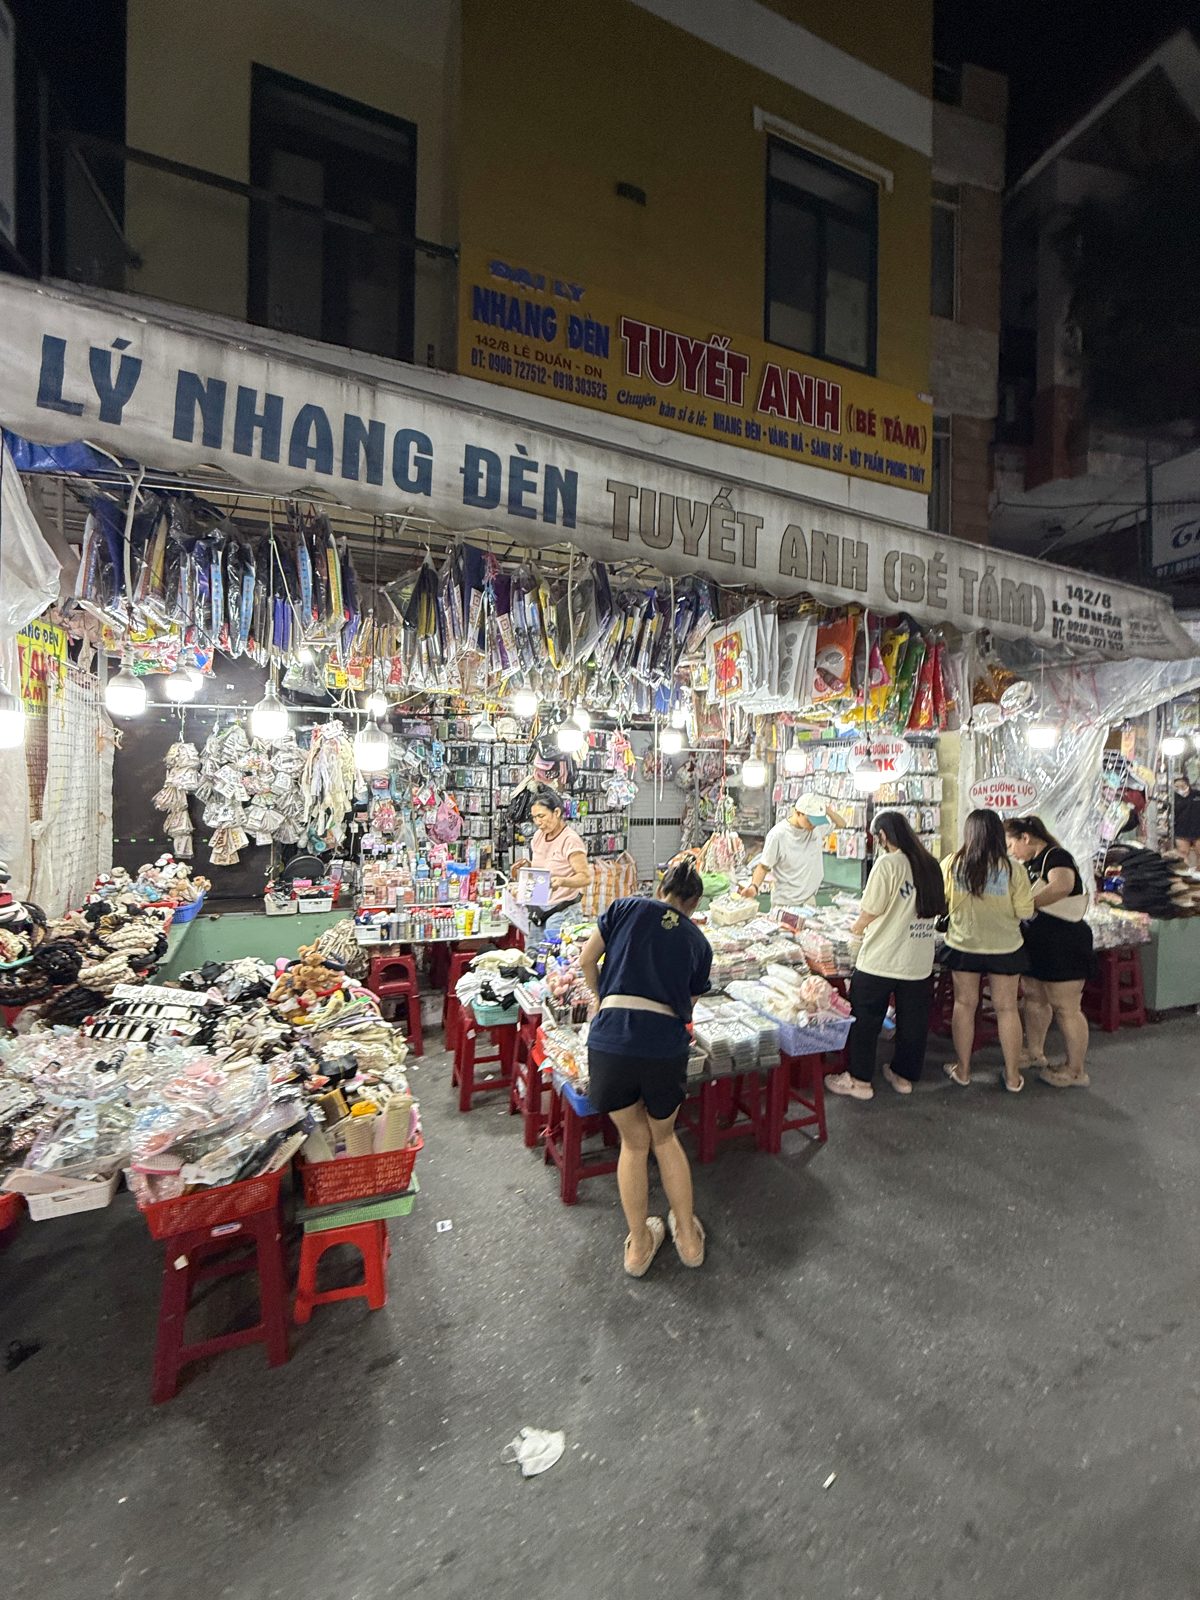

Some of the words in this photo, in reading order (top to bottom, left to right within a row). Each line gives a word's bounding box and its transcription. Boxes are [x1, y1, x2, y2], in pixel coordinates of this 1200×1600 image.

[471, 285, 557, 343] NHANG
[567, 312, 609, 360] ĐÈN
[475, 334, 510, 353] 142/8
[514, 344, 531, 359] LÊ
[584, 365, 603, 379] ĐN
[488, 352, 512, 376] 0906
[514, 359, 547, 385] 727512
[553, 370, 574, 392] 0918
[620, 314, 750, 408] TUYẾT
[757, 362, 842, 435] ANH
[846, 403, 877, 438] (BÉ
[883, 415, 927, 455] TÁM)
[36, 334, 142, 426] LÝ
[172, 369, 434, 497] NHANG
[459, 443, 578, 530] ĐÈN
[713, 411, 742, 437] NHANG
[606, 479, 764, 569] TUYẾT
[779, 523, 869, 592] ANH
[883, 550, 948, 610] (BÉ
[958, 565, 1046, 633] TÁM)
[1066, 584, 1112, 610] 142/8
[972, 784, 988, 796] DÁN
[1017, 783, 1034, 796] LỰC
[984, 794, 1018, 808] 20K
